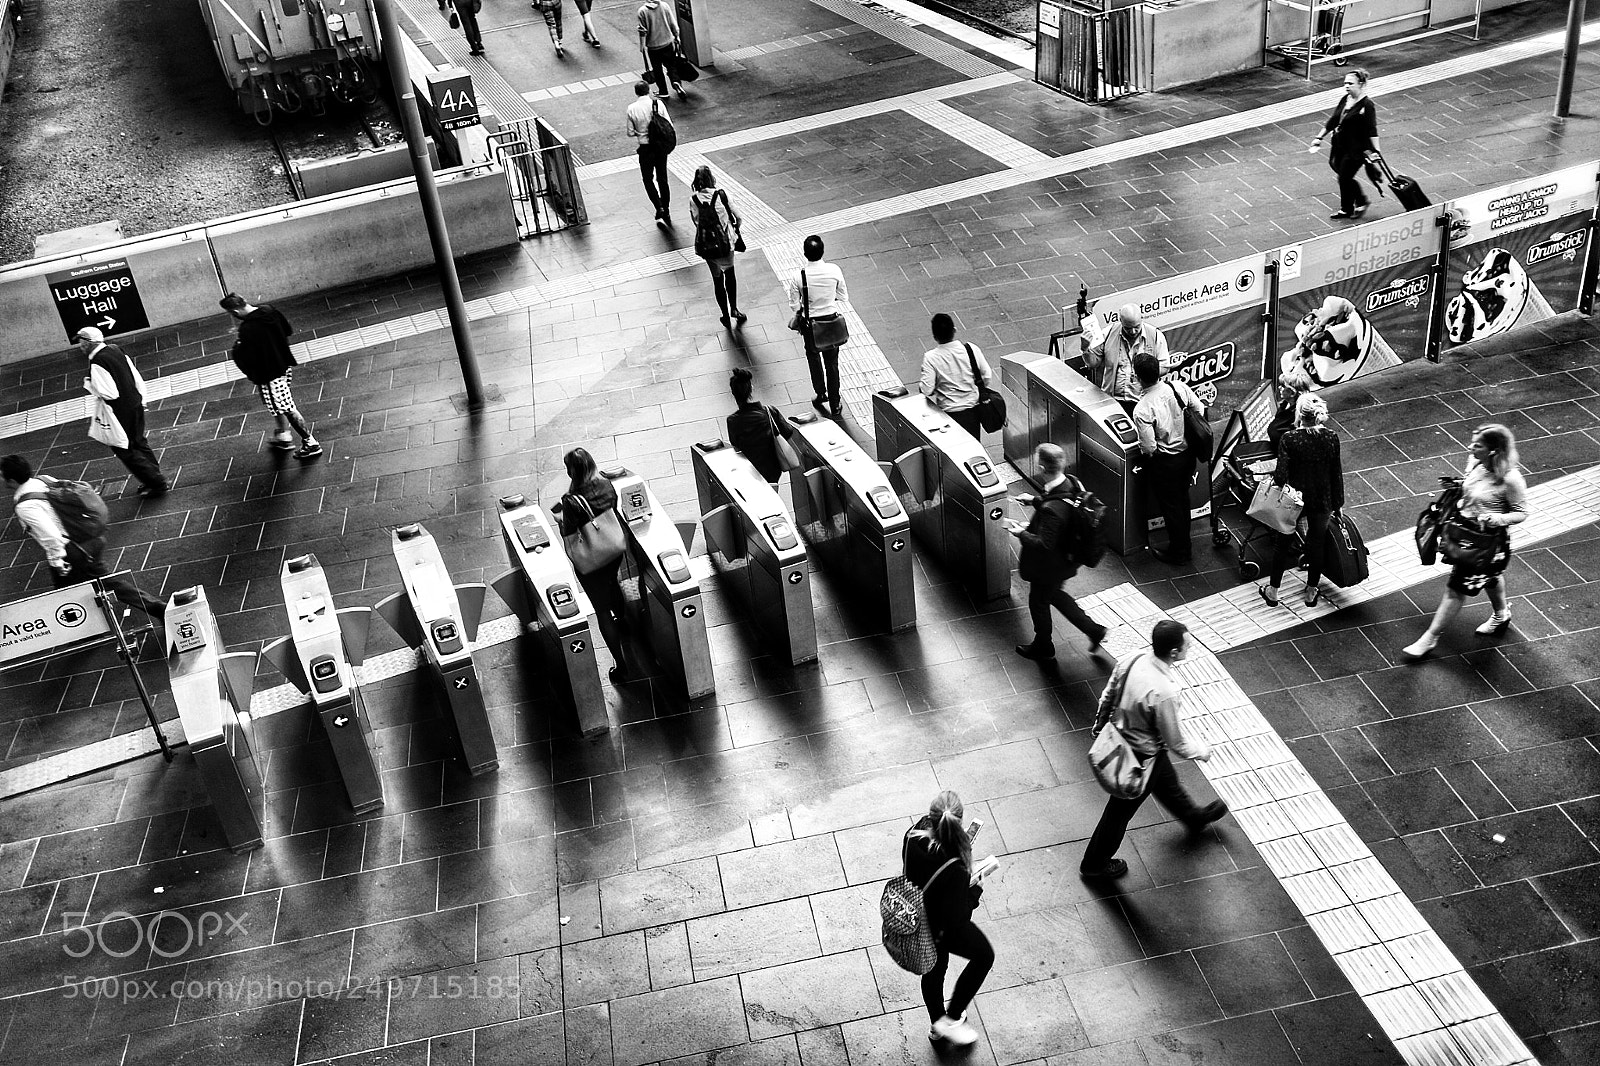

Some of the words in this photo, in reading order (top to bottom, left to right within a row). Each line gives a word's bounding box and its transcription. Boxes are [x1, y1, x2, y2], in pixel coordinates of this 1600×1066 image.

[440, 88, 475, 112] 4A
[1488, 194, 1521, 211] CRAVING
[1528, 183, 1558, 199] SNACK?
[1499, 205, 1521, 217] HEAD
[1521, 201, 1532, 211] UP
[1533, 197, 1544, 208] TO
[1491, 213, 1523, 230] HUNGRY
[1529, 232, 1584, 262] Drumstick
[55, 276, 131, 301] Luggage
[1162, 288, 1198, 308] Ticket
[1200, 281, 1229, 298] Area
[1369, 279, 1427, 309] Drumstick
[82, 296, 118, 315] Hall
[3, 618, 48, 639] Area
